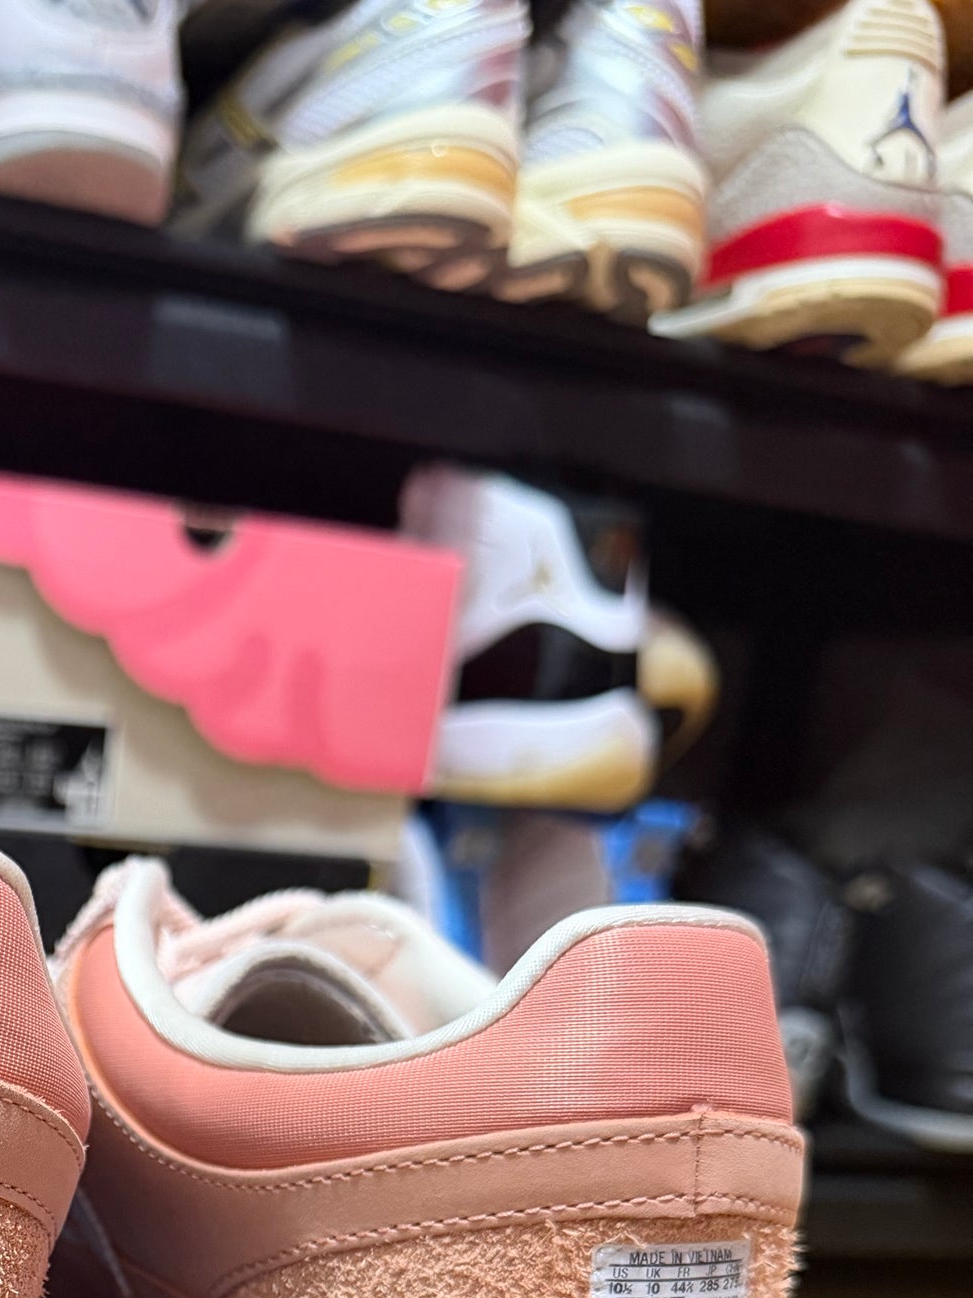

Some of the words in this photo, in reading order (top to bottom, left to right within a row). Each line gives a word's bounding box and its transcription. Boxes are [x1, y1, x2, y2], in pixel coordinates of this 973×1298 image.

[629, 1250, 665, 1264] MADE
[671, 1252, 682, 1263] IN
[688, 1249, 732, 1263] VIETNAM
[612, 1268, 628, 1278] US
[646, 1268, 661, 1278] UK
[677, 1267, 690, 1277] FR
[706, 1266, 716, 1275] JP
[647, 1282, 660, 1294] 10
[699, 1280, 719, 1293] 285
